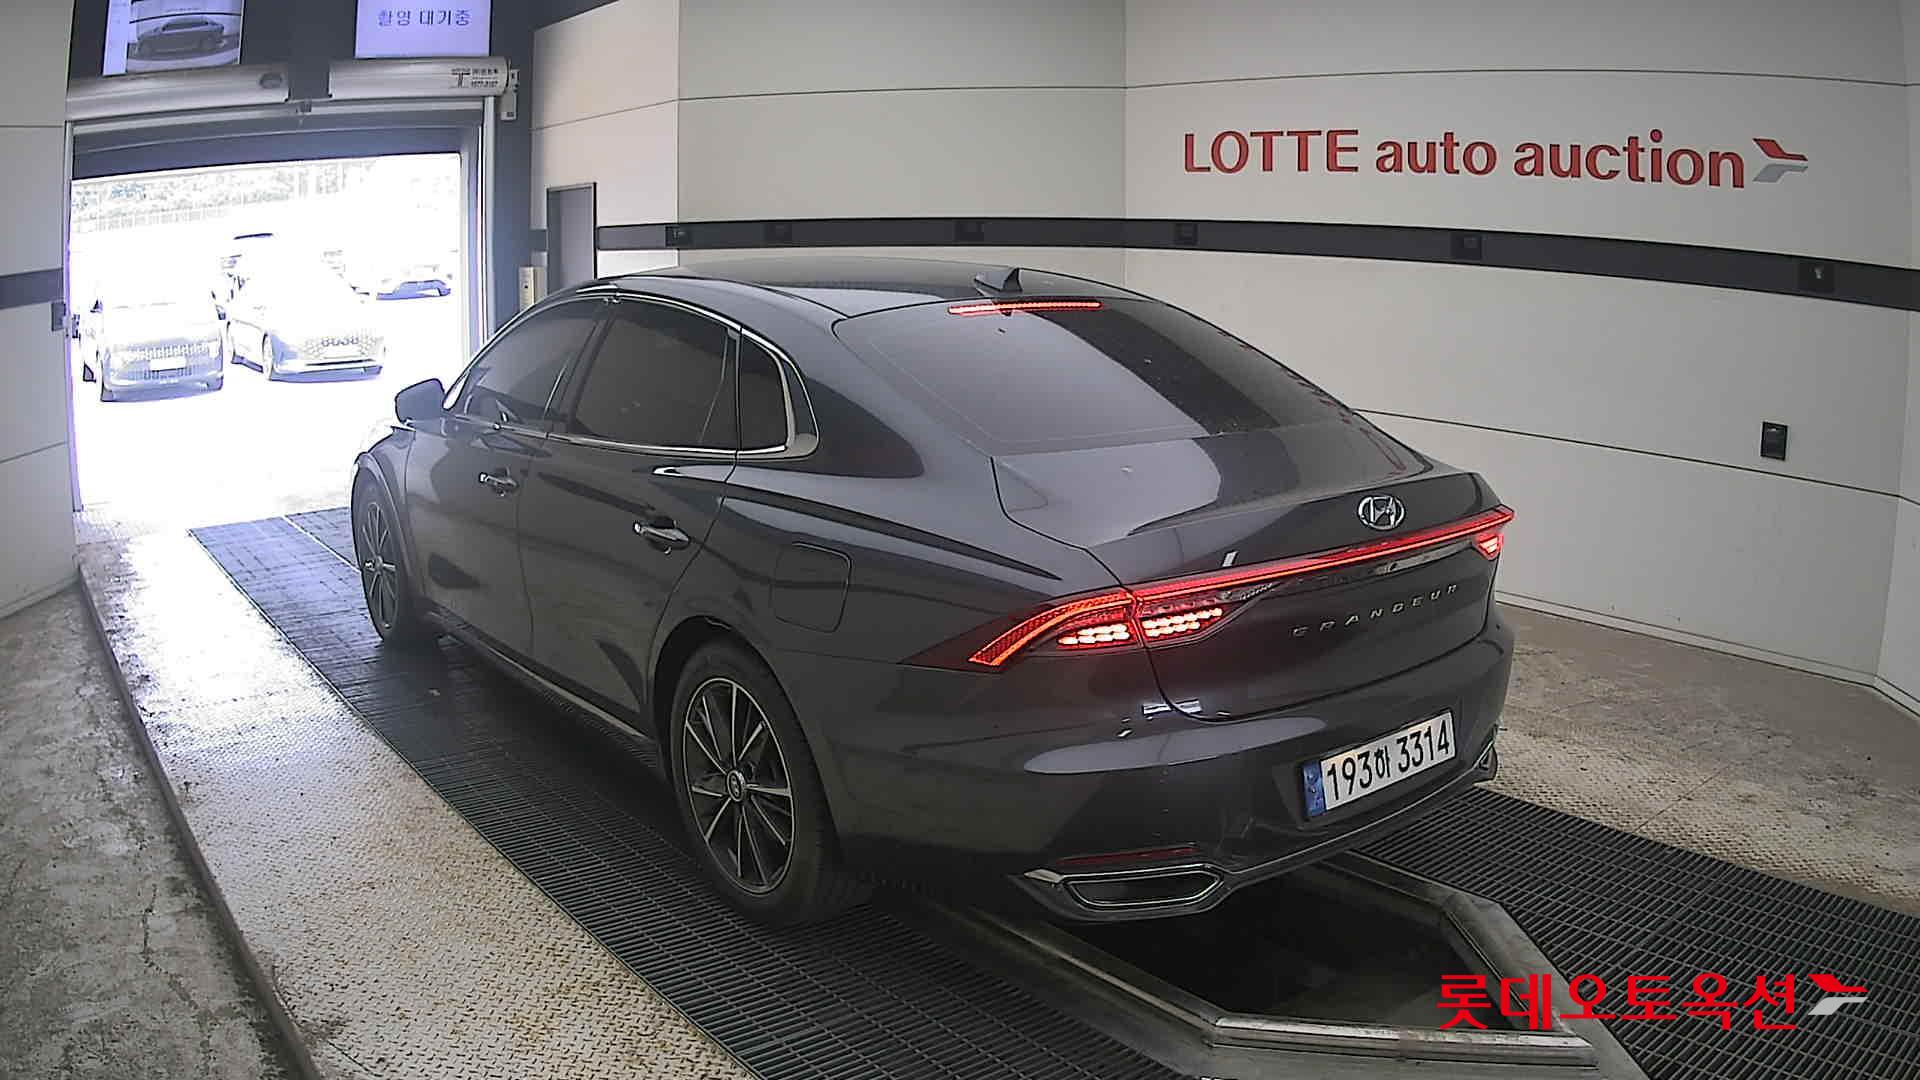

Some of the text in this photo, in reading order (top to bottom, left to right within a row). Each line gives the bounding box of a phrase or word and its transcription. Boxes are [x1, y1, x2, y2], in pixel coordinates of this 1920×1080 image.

[419, 9, 472, 26] 대기중
[1183, 129, 1745, 189] LOTTE auto auction
[1292, 583, 1457, 638] GRANDEUR
[1326, 719, 1450, 801] 193하 3314
